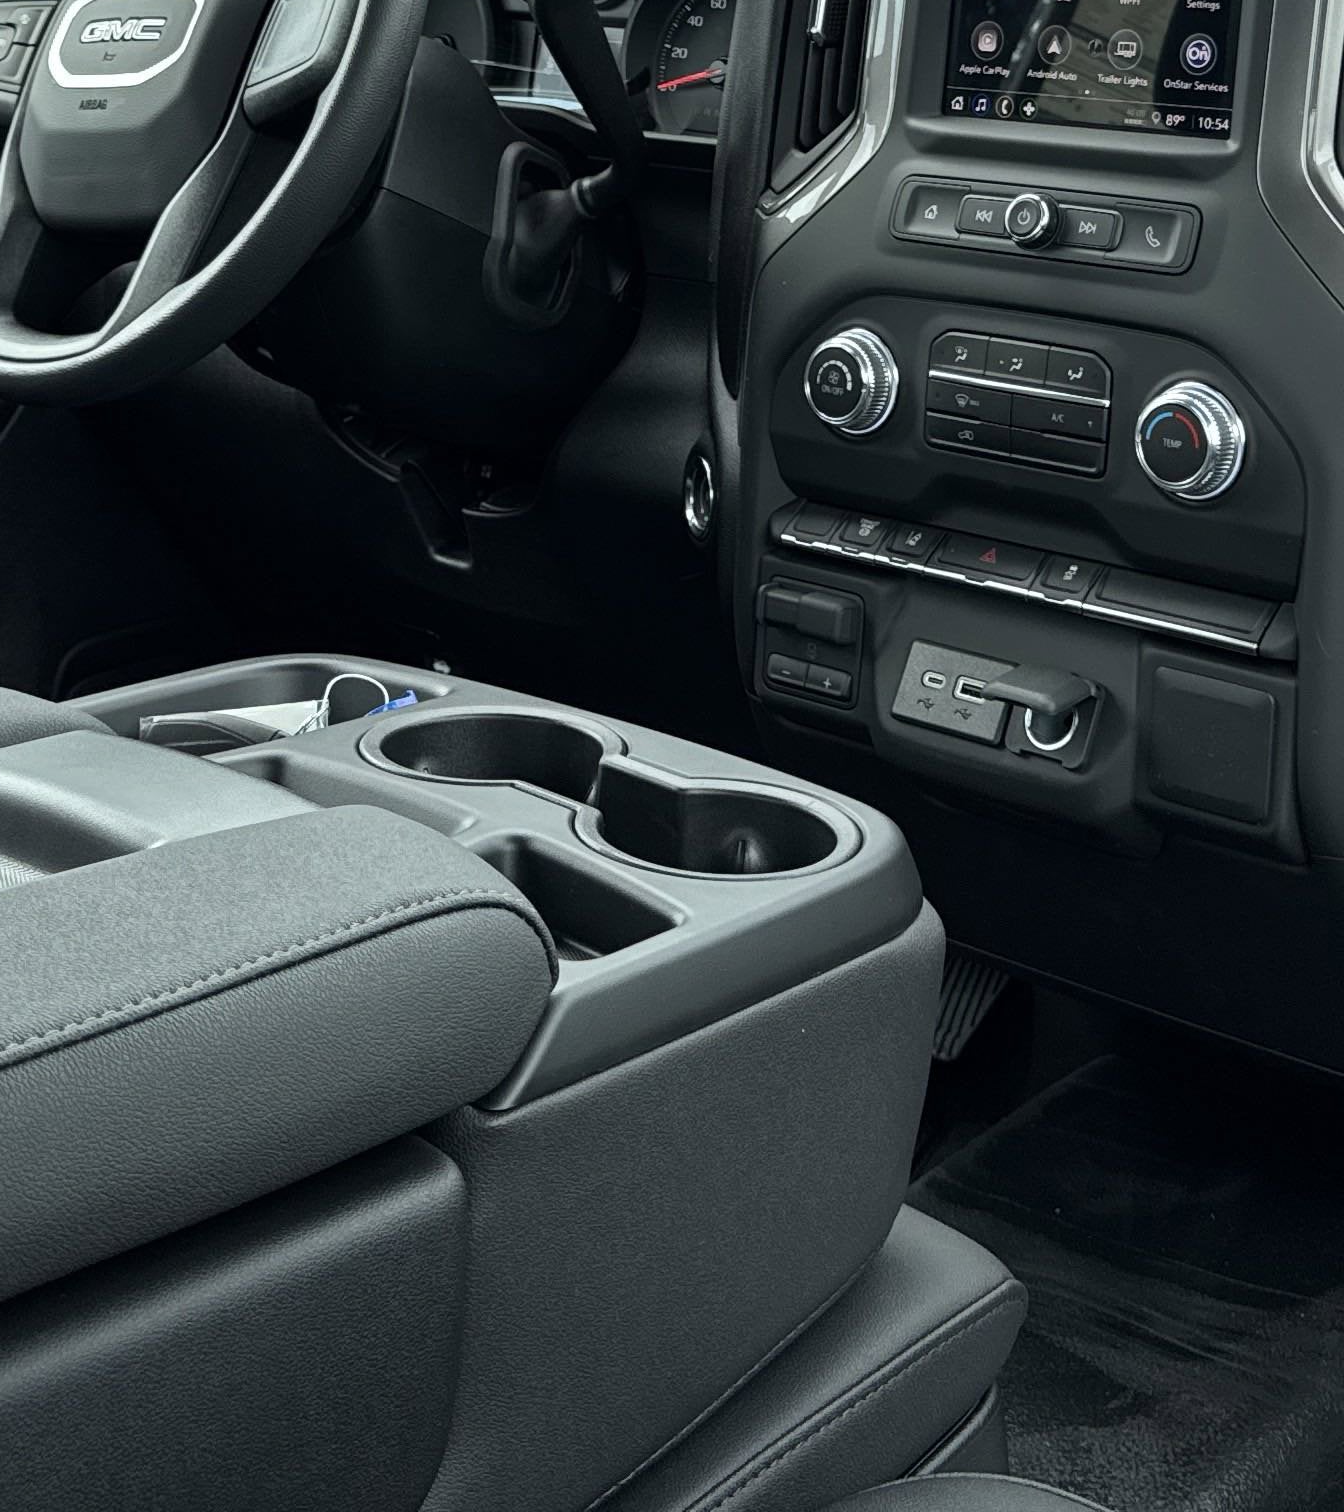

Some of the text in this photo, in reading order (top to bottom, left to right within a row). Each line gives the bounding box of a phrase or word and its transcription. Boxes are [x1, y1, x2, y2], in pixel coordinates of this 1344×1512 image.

[1186, 0, 1221, 11] Settings
[687, 15, 704, 27] 40
[80, 16, 168, 44] GMC
[671, 47, 688, 59] 20
[959, 64, 982, 77] Apple
[1123, 76, 1148, 88] Lights
[1163, 78, 1229, 92] OnStar Services
[79, 99, 108, 110] AIRBAG
[1198, 117, 1229, 130] 10:54
[1051, 413, 1064, 424] A/C
[1162, 437, 1183, 450] TEMP
